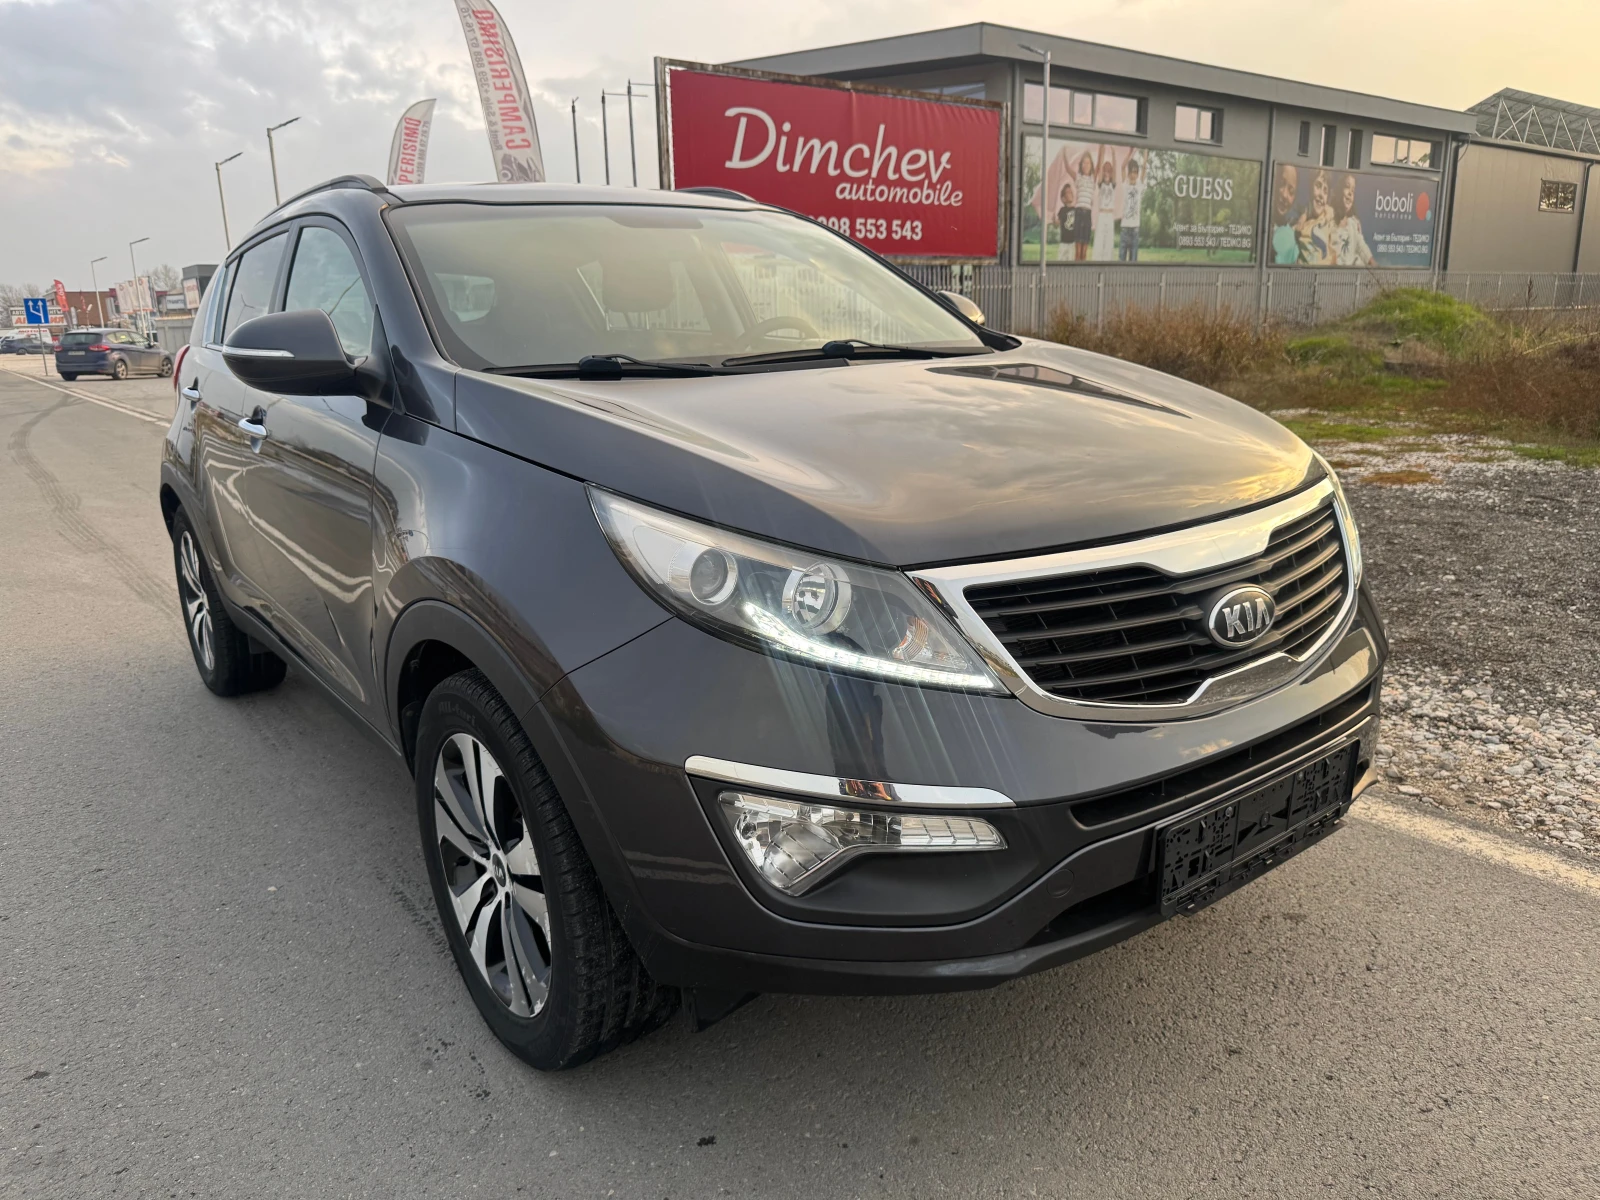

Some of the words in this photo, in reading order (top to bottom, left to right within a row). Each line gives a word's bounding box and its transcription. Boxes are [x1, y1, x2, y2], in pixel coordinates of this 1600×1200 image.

[724, 106, 952, 184] Dimchev
[835, 178, 963, 206] automobile
[1174, 175, 1233, 201] GUESS
[1375, 190, 1413, 212] boboli
[855, 218, 887, 239] 553
[892, 220, 922, 241] 543
[1222, 598, 1270, 638] KIA
